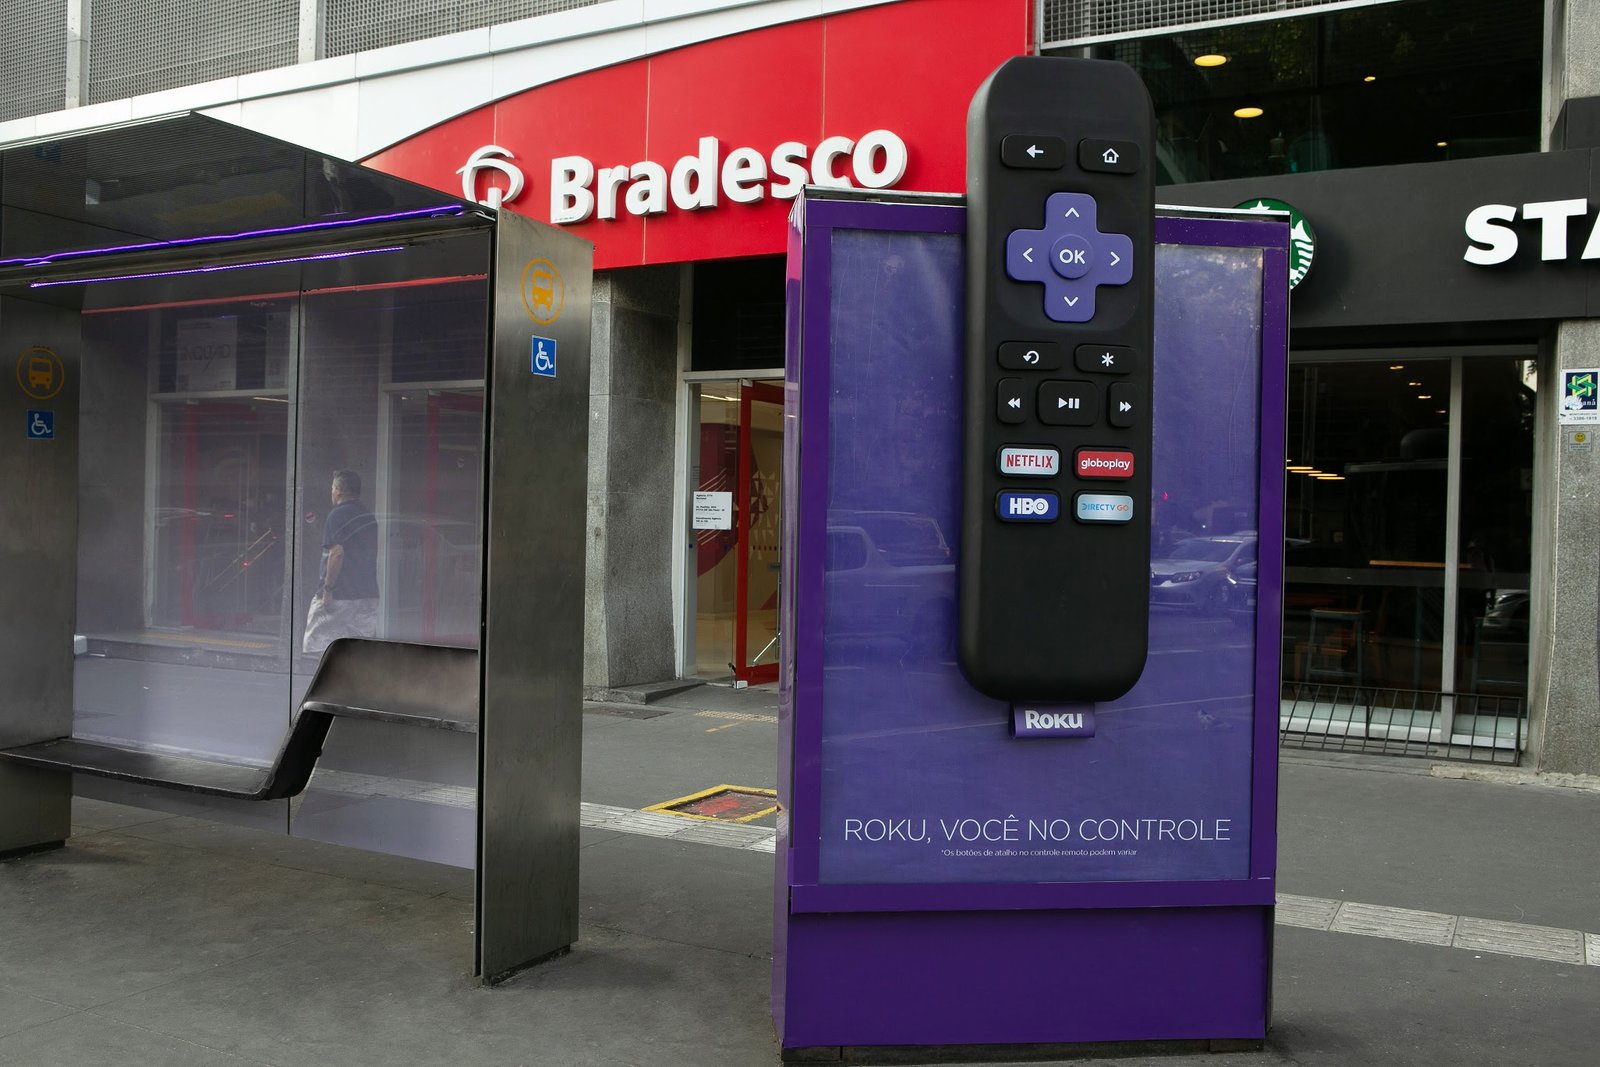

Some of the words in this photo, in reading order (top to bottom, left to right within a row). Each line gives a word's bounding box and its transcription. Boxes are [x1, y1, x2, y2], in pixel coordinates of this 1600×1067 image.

[551, 129, 908, 224] Bradesco
[1059, 249, 1085, 264] OK
[1006, 454, 1053, 469] NETFLIX
[1081, 458, 1130, 470] globoplay
[1009, 497, 1049, 515] HBO
[1082, 503, 1116, 511] DIRECTV
[844, 819, 931, 844] ROKU,
[940, 814, 1019, 841] VOCÊ
[1028, 819, 1070, 841] NO
[1079, 819, 1231, 841] CONTROLE
